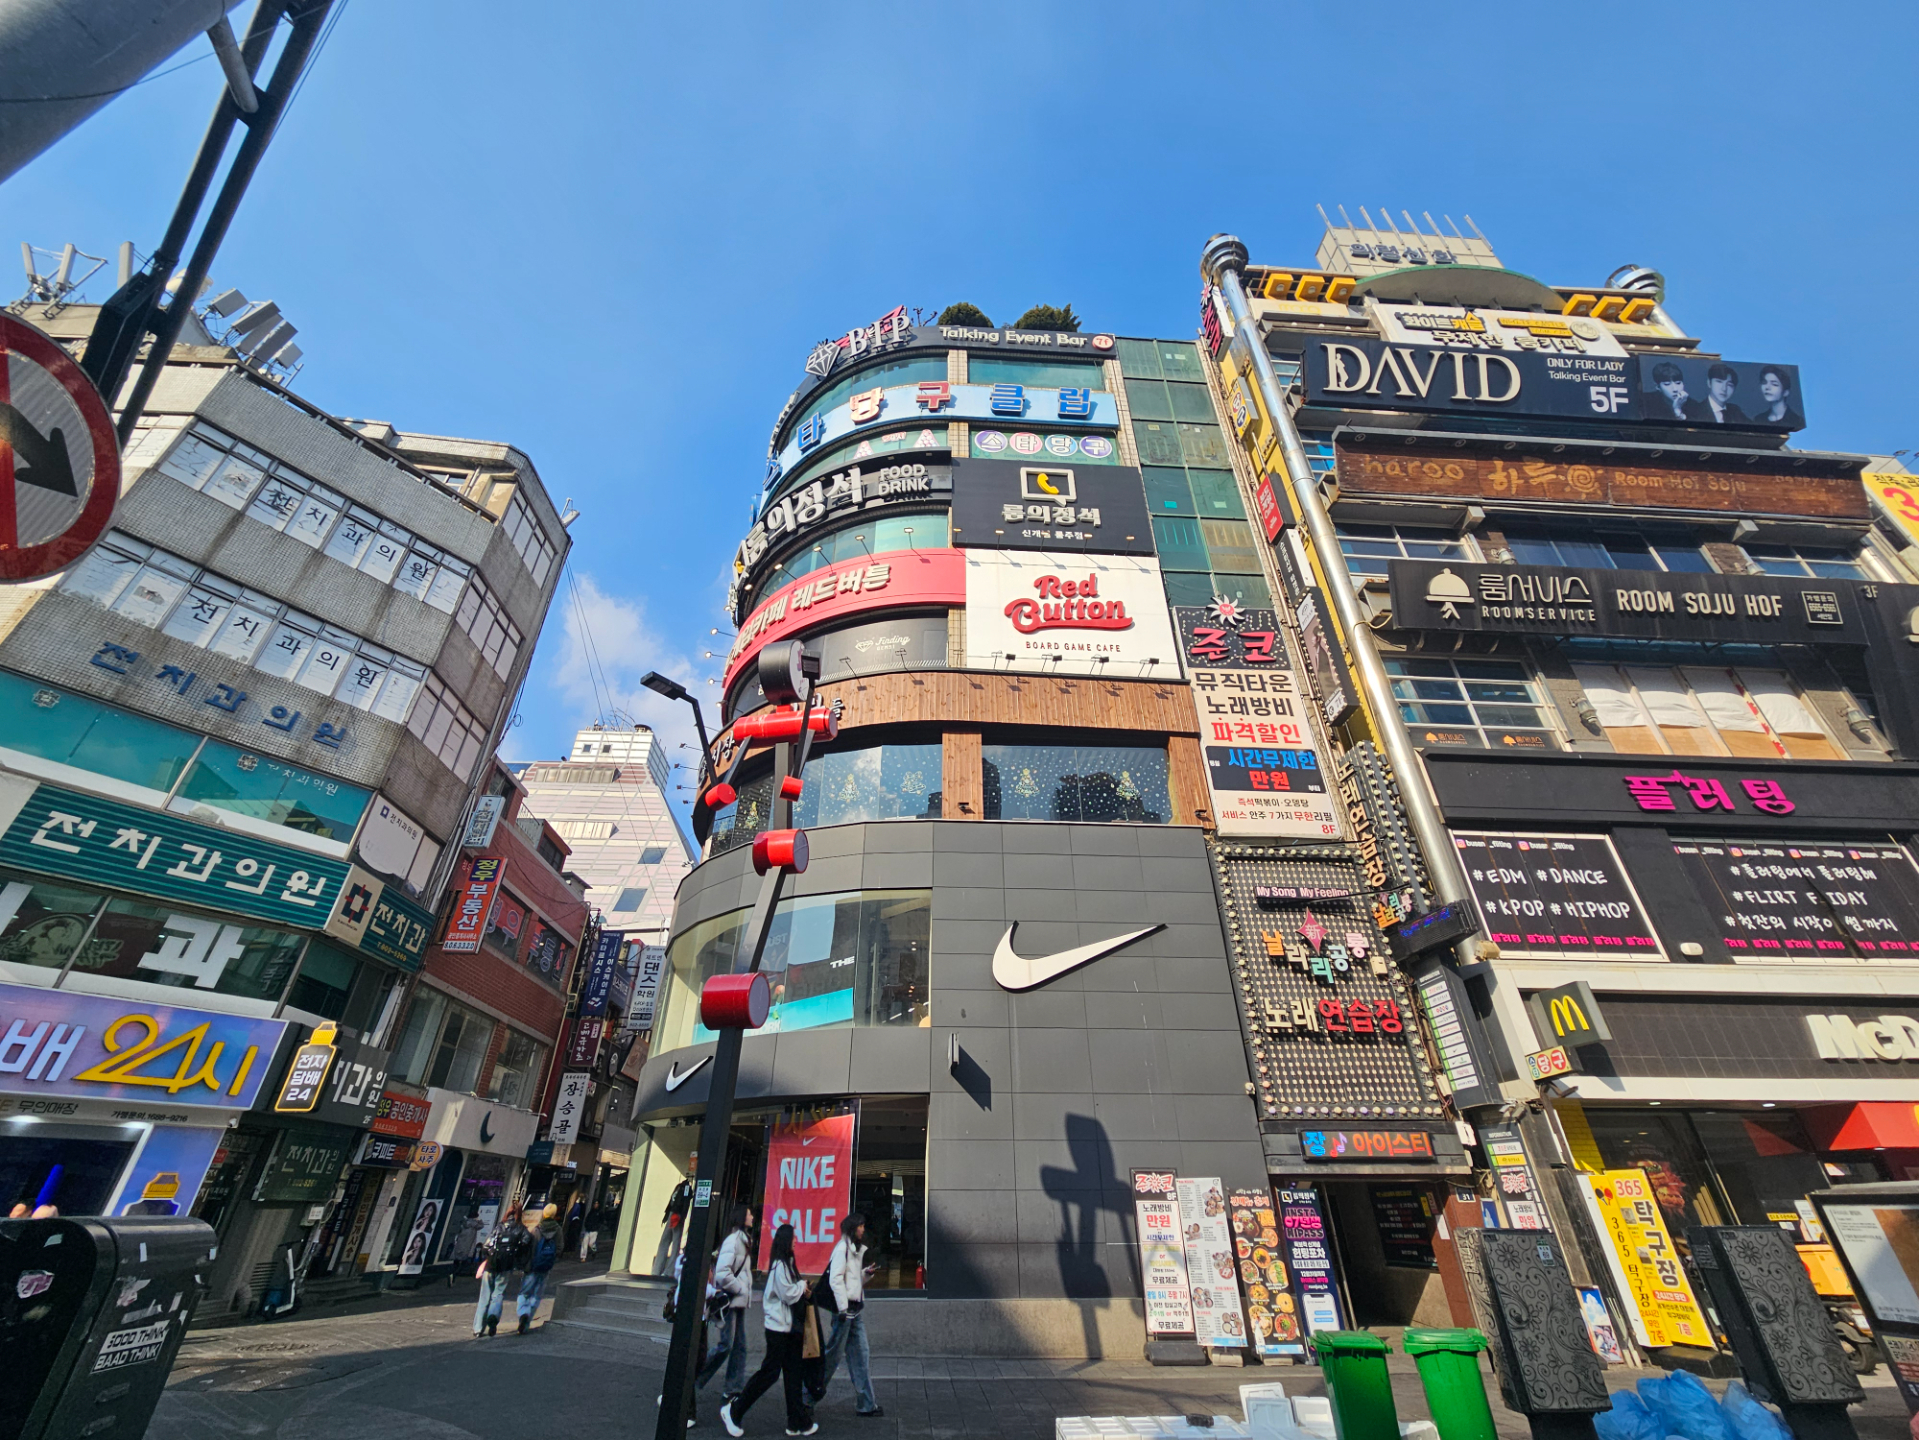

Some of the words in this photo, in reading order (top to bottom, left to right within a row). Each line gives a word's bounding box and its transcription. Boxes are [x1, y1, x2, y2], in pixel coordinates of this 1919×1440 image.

[846, 314, 911, 358] BIP
[939, 326, 999, 343] Talking
[1005, 330, 1052, 345] Event
[1056, 332, 1087, 347] Bar
[1432, 331, 1503, 347] 무제한
[1321, 342, 1521, 402] DAVID
[1547, 357, 1573, 369] ONLY
[1576, 359, 1595, 370] FOR
[1597, 361, 1625, 372] LADY
[1548, 370, 1581, 383] Talking
[1582, 372, 1608, 382] Event
[1609, 375, 1626, 383] Bar
[1590, 386, 1629, 413] 5F
[980, 431, 1111, 457] 스타당구
[879, 464, 926, 482] FOOD
[1365, 454, 1464, 480] haroo
[1487, 456, 1557, 498] 하루
[878, 478, 930, 496] DRINK
[1615, 471, 1663, 487] Room
[1707, 475, 1747, 496] Soju
[1001, 503, 1101, 527] 룸의정석
[791, 564, 891, 610] 레드버튼
[1033, 573, 1100, 599] Red
[1479, 573, 1592, 603] 룸서비스
[1616, 588, 1675, 613] ROOM
[1686, 592, 1736, 615] SOJU
[1745, 595, 1782, 617] HOF
[1864, 585, 1879, 598] 3F
[1004, 597, 1133, 634] Button
[1482, 606, 1596, 622] ROOMSERVICE
[192, 587, 378, 688] 전치과의원
[875, 635, 911, 647] Finding
[1025, 641, 1060, 651] BOARD
[1064, 642, 1092, 652] GAME
[1096, 644, 1121, 653] CAFE
[1190, 627, 1277, 662] 준코
[1195, 672, 1293, 694] 뮤직타운
[90, 641, 347, 749] 전치과의원
[1206, 695, 1294, 717] 노래방비
[1212, 720, 1303, 744] 파격할인
[1228, 748, 1317, 770] 시간무제한
[1248, 770, 1291, 790] 만원
[1624, 769, 1796, 815] 플러팅
[1222, 810, 1248, 820] 서비스
[1249, 811, 1267, 820] 안주
[1277, 812, 1293, 820] 가지
[1294, 811, 1334, 822] 무한리필
[1321, 825, 1336, 834] 8F
[30, 810, 327, 907] 전치과의원
[472, 859, 500, 881] 정우
[1473, 868, 1528, 885] #EDM
[1536, 868, 1608, 885] #DANCE
[1256, 886, 1270, 897] My
[1272, 886, 1298, 898] Song
[1300, 888, 1314, 898] My
[1733, 890, 1798, 904] #FLIRT
[1806, 891, 1869, 905] FIDAY
[456, 883, 488, 931] 부동산
[1550, 901, 1631, 919] #HIPHOP
[369, 902, 426, 954] 전치과
[1305, 923, 1321, 940] 新
[829, 956, 855, 969] THE
[639, 962, 660, 988] 댄스
[637, 990, 655, 998] 학원
[72, 1013, 259, 1096] 24시
[297, 1054, 329, 1069] 전자
[290, 1071, 322, 1086] 담배
[286, 1088, 312, 1101] 24
[18, 1100, 79, 1115] 무인매장
[390, 1100, 428, 1125] 공인중개사
[363, 1115, 372, 1125] 2F
[421, 1145, 437, 1154] 타로
[1353, 1131, 1433, 1157] 아이스티
[281, 1146, 331, 1174] 전치과
[417, 1156, 434, 1164] 사주
[780, 1155, 836, 1190] NIKE
[1166, 1192, 1177, 1201] 8F
[1615, 1180, 1643, 1196] 365
[1142, 1204, 1173, 1213] 노래방비
[1286, 1208, 1317, 1217] INSTA
[771, 1208, 836, 1243] SALE
[1146, 1214, 1172, 1228] 만원
[1611, 1216, 1630, 1259] 365
[1633, 1200, 1680, 1287] 탁구장
[1152, 1276, 1179, 1284] 무료제공
[1628, 1263, 1651, 1308] 탁구장
[137, 1326, 165, 1341] THINK
[1158, 1321, 1185, 1330] 무료제공
[1675, 1322, 1693, 1336] 7층
[1650, 1330, 1666, 1343] 7층
[93, 1351, 129, 1371] BAAD
[128, 1343, 160, 1362] THINK
